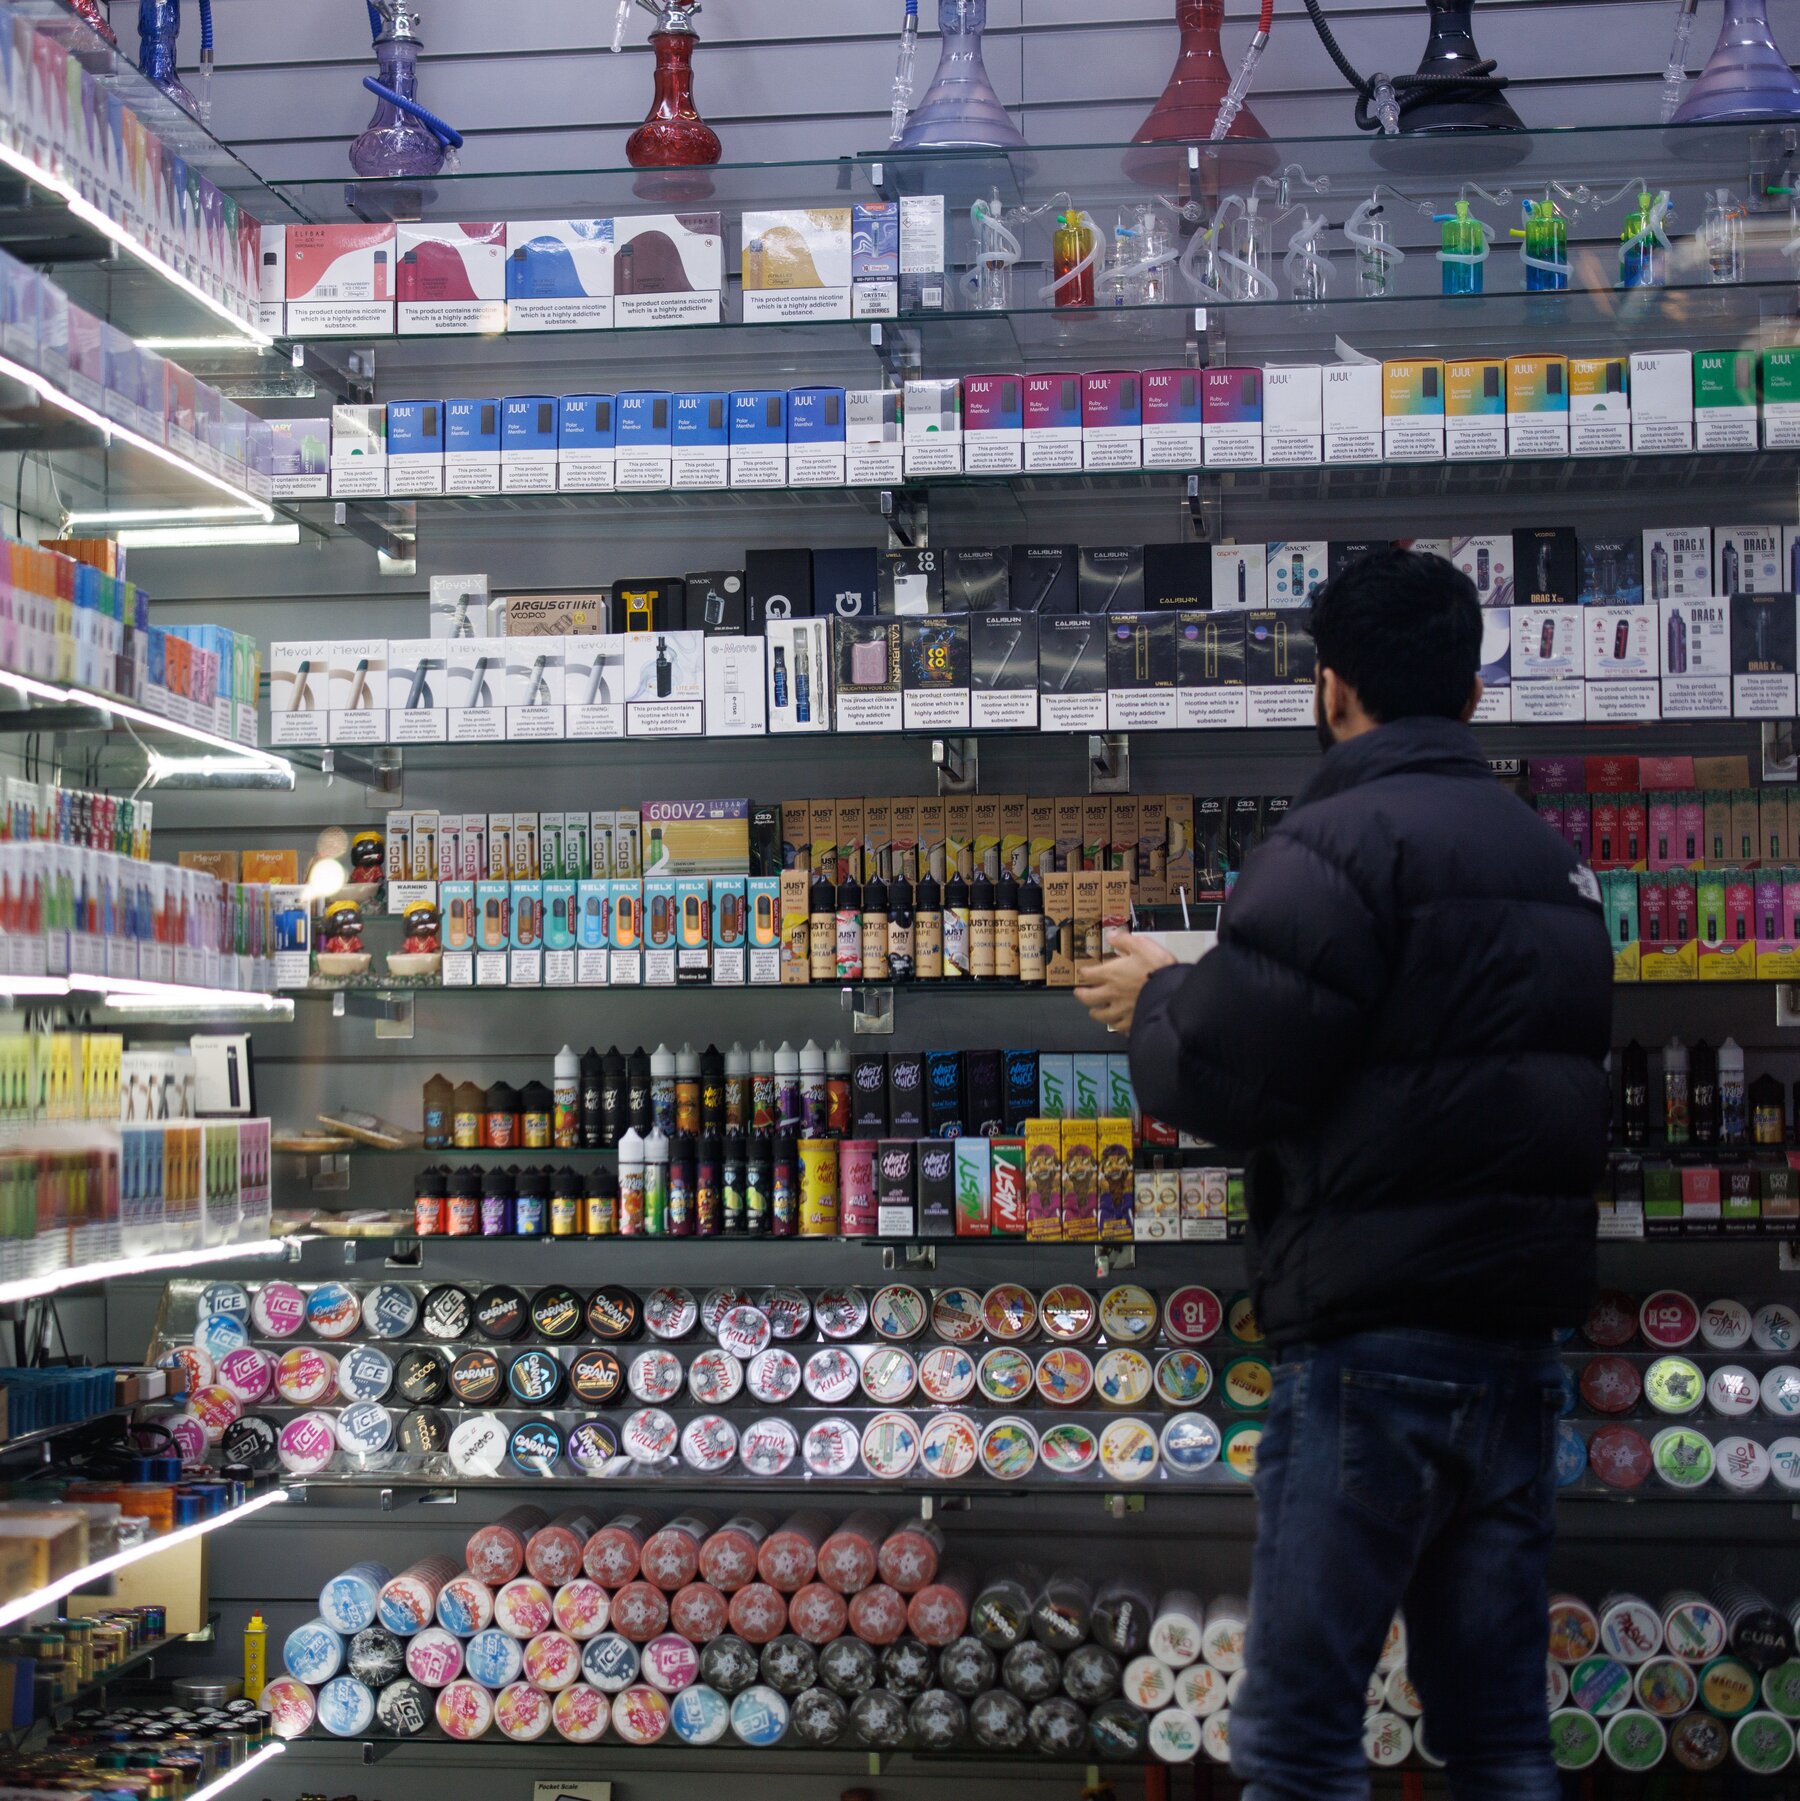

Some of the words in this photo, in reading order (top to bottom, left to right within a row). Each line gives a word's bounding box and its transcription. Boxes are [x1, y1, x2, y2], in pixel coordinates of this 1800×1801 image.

[1674, 540, 1696, 550] DRAG
[1699, 539, 1704, 550] X
[1744, 539, 1766, 550] DRAG
[1770, 538, 1775, 550] X
[511, 601, 556, 610] ARGUS
[558, 601, 572, 610] GT
[581, 600, 596, 609] kit
[1531, 594, 1550, 603] DRAG
[1552, 594, 1557, 603] X
[275, 647, 311, 656] Mevol
[316, 647, 323, 655] X
[333, 645, 370, 655] Mevol
[1748, 662, 1768, 671] DRAG
[1770, 662, 1775, 670] X
[919, 692, 941, 700] product
[650, 804, 705, 819] 600V2
[193, 854, 221, 863] Mevol
[256, 853, 283, 861] Mevol
[1047, 882, 1069, 890] JUST
[1050, 888, 1066, 896] CBD
[891, 1064, 920, 1076] NASTY
[893, 1075, 918, 1086] JUICE
[923, 1151, 949, 1164] NASTY
[924, 1162, 948, 1175] JUICE
[958, 1155, 980, 1220] NASTY
[992, 1154, 1016, 1221] NASTY
[217, 1298, 241, 1309] ICE
[273, 1300, 298, 1313] ICE
[478, 1299, 518, 1320] GARANT
[596, 1295, 629, 1325] GARANT
[534, 1300, 574, 1321] GARANT
[1660, 1307, 1682, 1329] 18
[727, 1330, 757, 1344] KILLA
[236, 1356, 259, 1378] ICE
[358, 1367, 384, 1380] ICE
[454, 1367, 495, 1380] GARANT
[404, 1361, 436, 1389] NICCOS
[643, 1360, 655, 1391] KILLA
[821, 1370, 849, 1392] KILLA
[295, 1421, 318, 1450] ICE
[632, 1431, 662, 1450] KILLA
[515, 1435, 555, 1458] GARANT
[1741, 1631, 1787, 1649] CUBA
[663, 1652, 688, 1666] ICE
[429, 1652, 443, 1680] ICE
